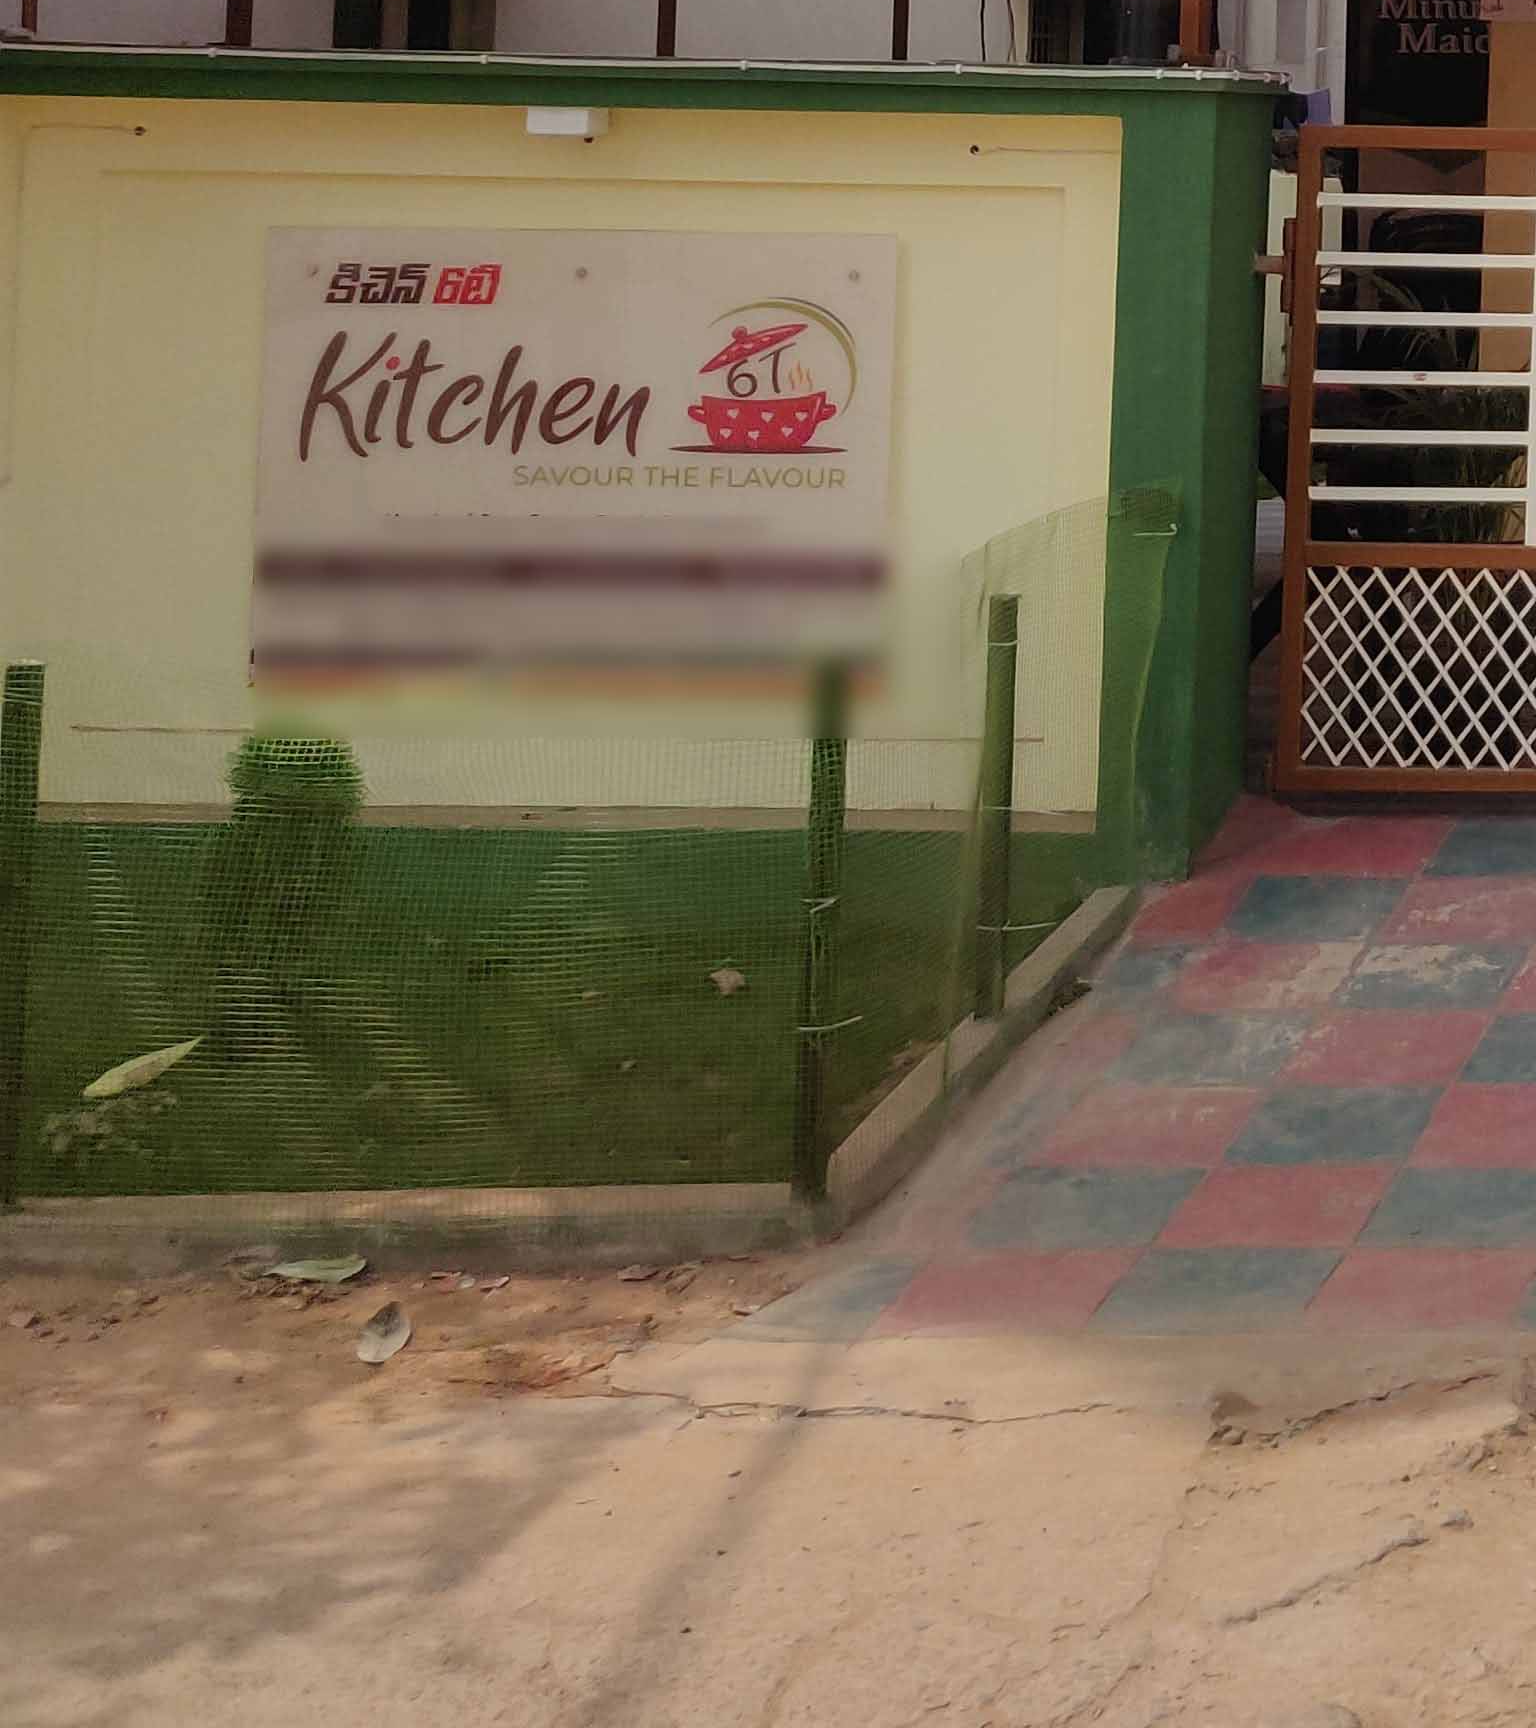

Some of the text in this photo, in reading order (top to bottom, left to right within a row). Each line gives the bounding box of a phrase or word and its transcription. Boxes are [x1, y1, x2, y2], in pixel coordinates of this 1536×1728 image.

[300, 330, 651, 462] Kitchen
[511, 464, 846, 489] SAVOUR THE FLAVOUR
